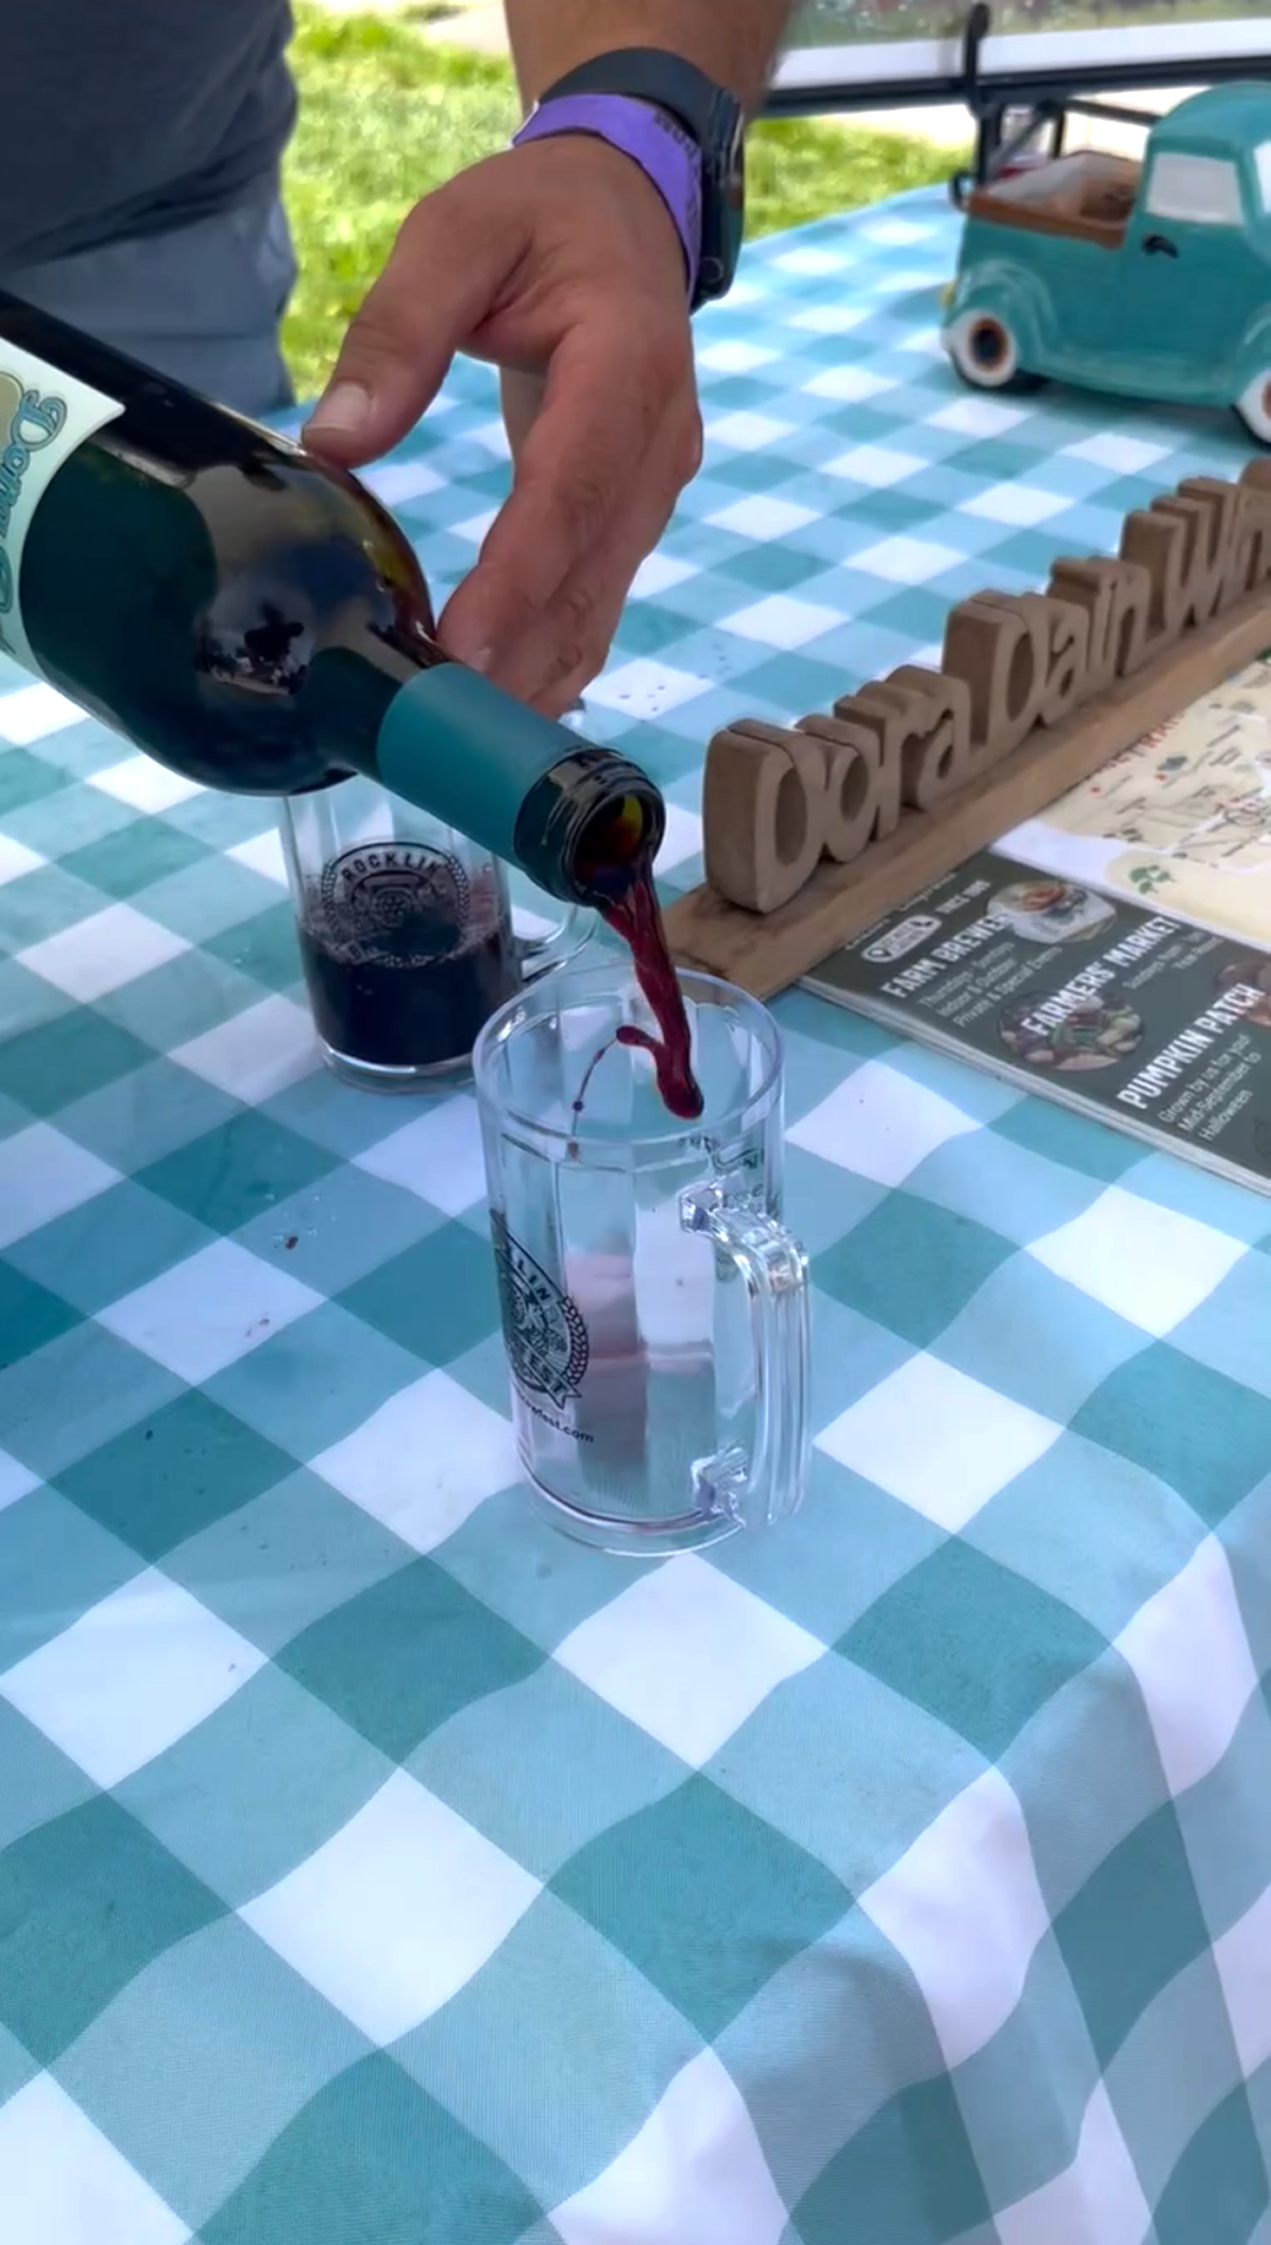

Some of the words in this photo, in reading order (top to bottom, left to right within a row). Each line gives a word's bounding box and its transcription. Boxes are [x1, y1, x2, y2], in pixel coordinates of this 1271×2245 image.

[704, 664, 972, 912] Dora
[342, 852, 442, 882] ROCKLIN
[1102, 916, 1182, 968] MARKET
[880, 958, 946, 998] FARM
[952, 999, 994, 1028] Private
[994, 963, 1034, 995] Special
[1116, 1029, 1215, 1110] PUMPKIN
[1193, 983, 1266, 1034] PATCH
[1210, 1053, 1233, 1068] for
[1244, 1052, 1262, 1064] to
[1186, 1078, 1210, 1092] by
[1201, 1067, 1220, 1080] us
[1157, 1090, 1196, 1123] Grown
[1198, 1089, 1254, 1141] Halloween
